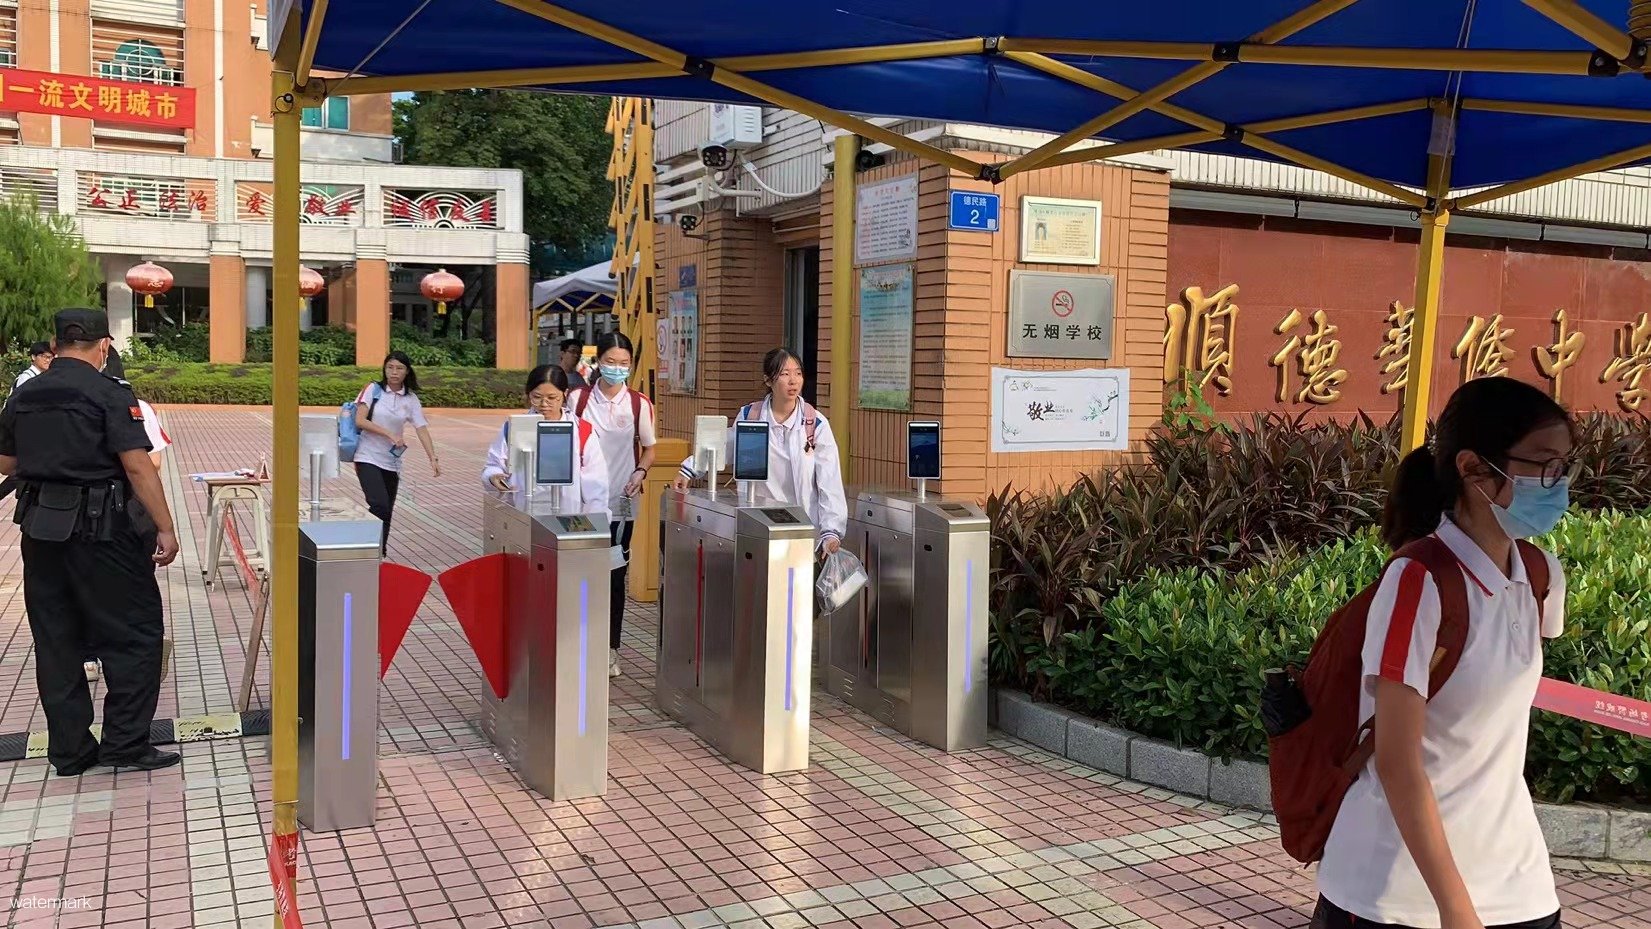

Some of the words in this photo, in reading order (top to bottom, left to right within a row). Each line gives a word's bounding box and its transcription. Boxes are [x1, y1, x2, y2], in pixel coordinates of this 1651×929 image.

[0, 74, 179, 120] 一流文明城市
[963, 195, 987, 207] 德民路
[970, 209, 979, 224] 2
[1022, 323, 1102, 340] 无烟学校
[1027, 400, 1055, 421] 敬业
